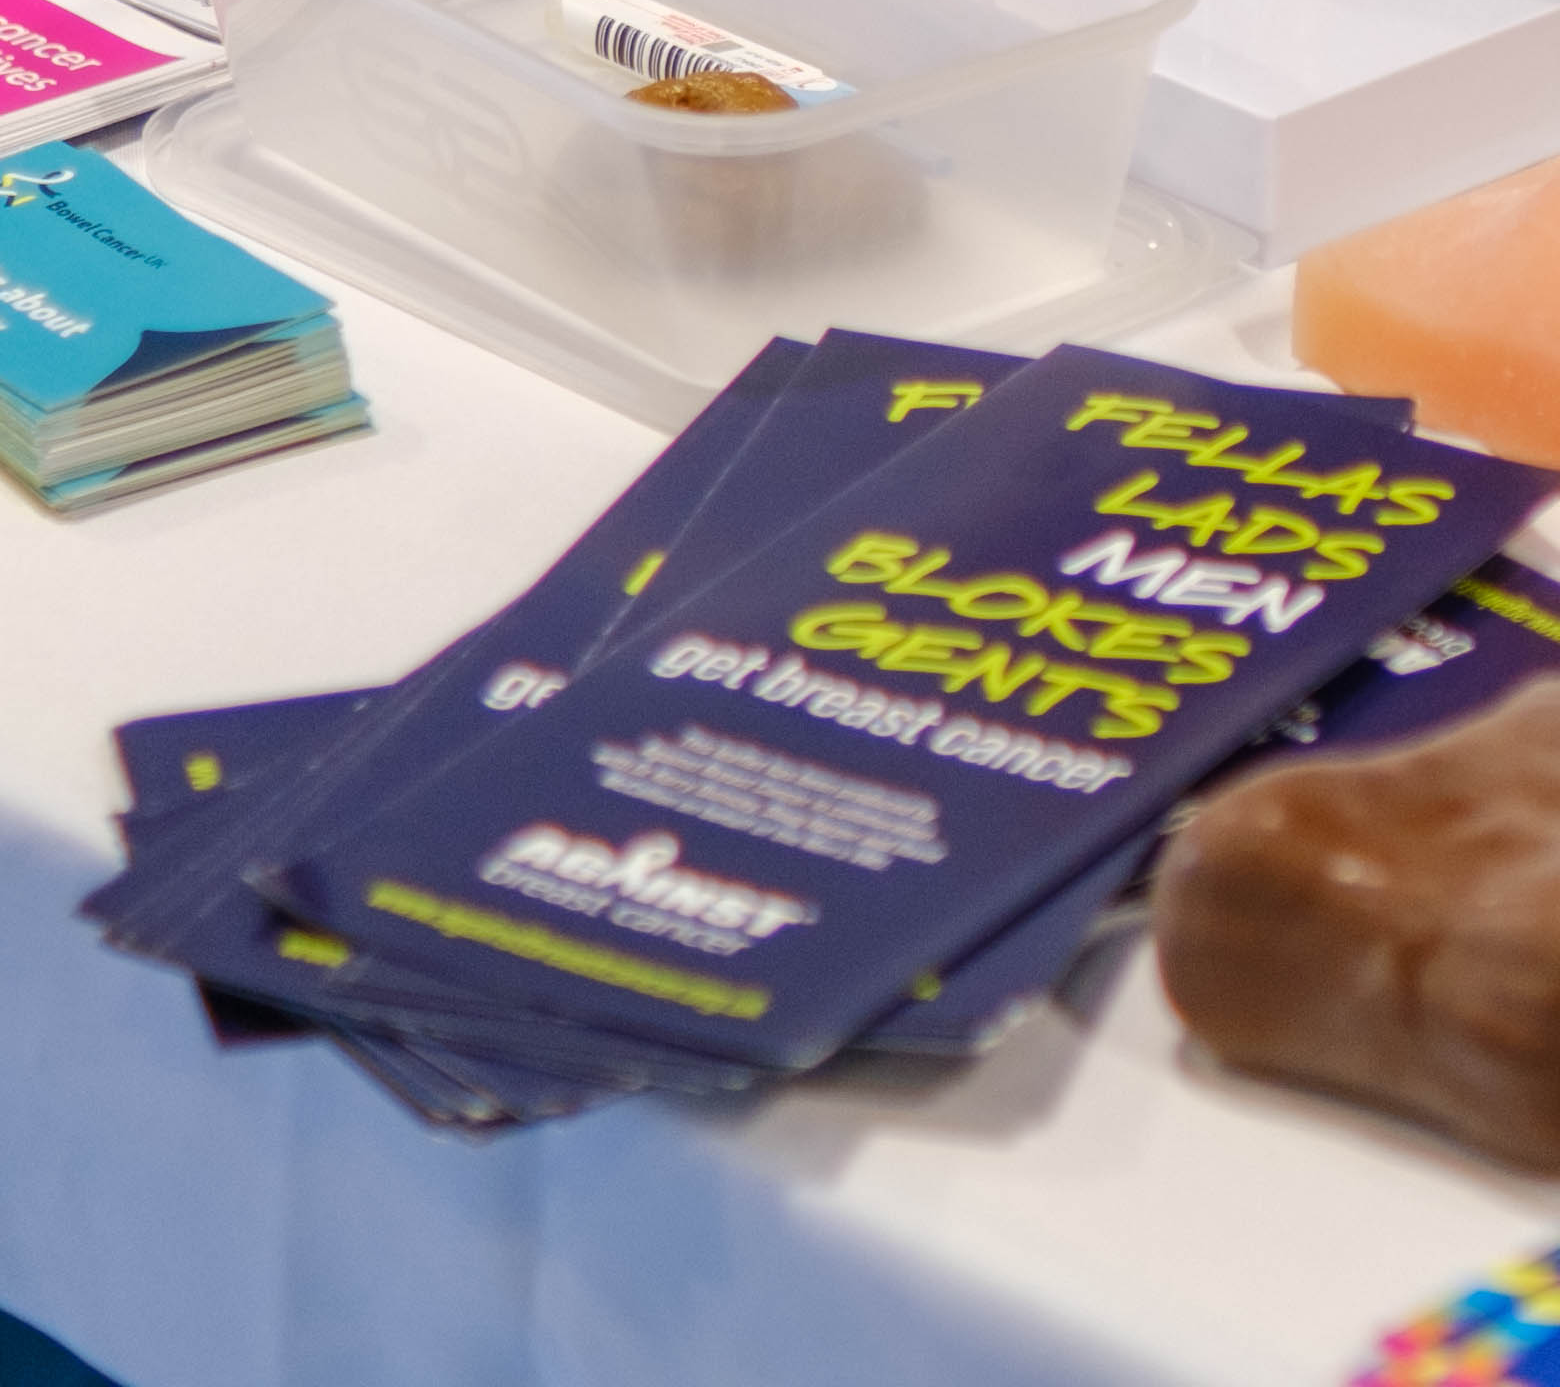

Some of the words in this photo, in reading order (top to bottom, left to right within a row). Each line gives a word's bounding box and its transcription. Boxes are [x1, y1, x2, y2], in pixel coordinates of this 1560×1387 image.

[45, 199, 103, 233] Bowel
[91, 228, 146, 260] Cancer
[1066, 393, 1456, 526] FELLAS
[1094, 471, 1385, 581] LADS
[826, 532, 1251, 685] BLOKES
[1060, 531, 1324, 634] MEN
[650, 635, 769, 690] get
[753, 656, 953, 746] breast
[929, 717, 1132, 794] cancer
[790, 603, 1180, 739] GENTS
